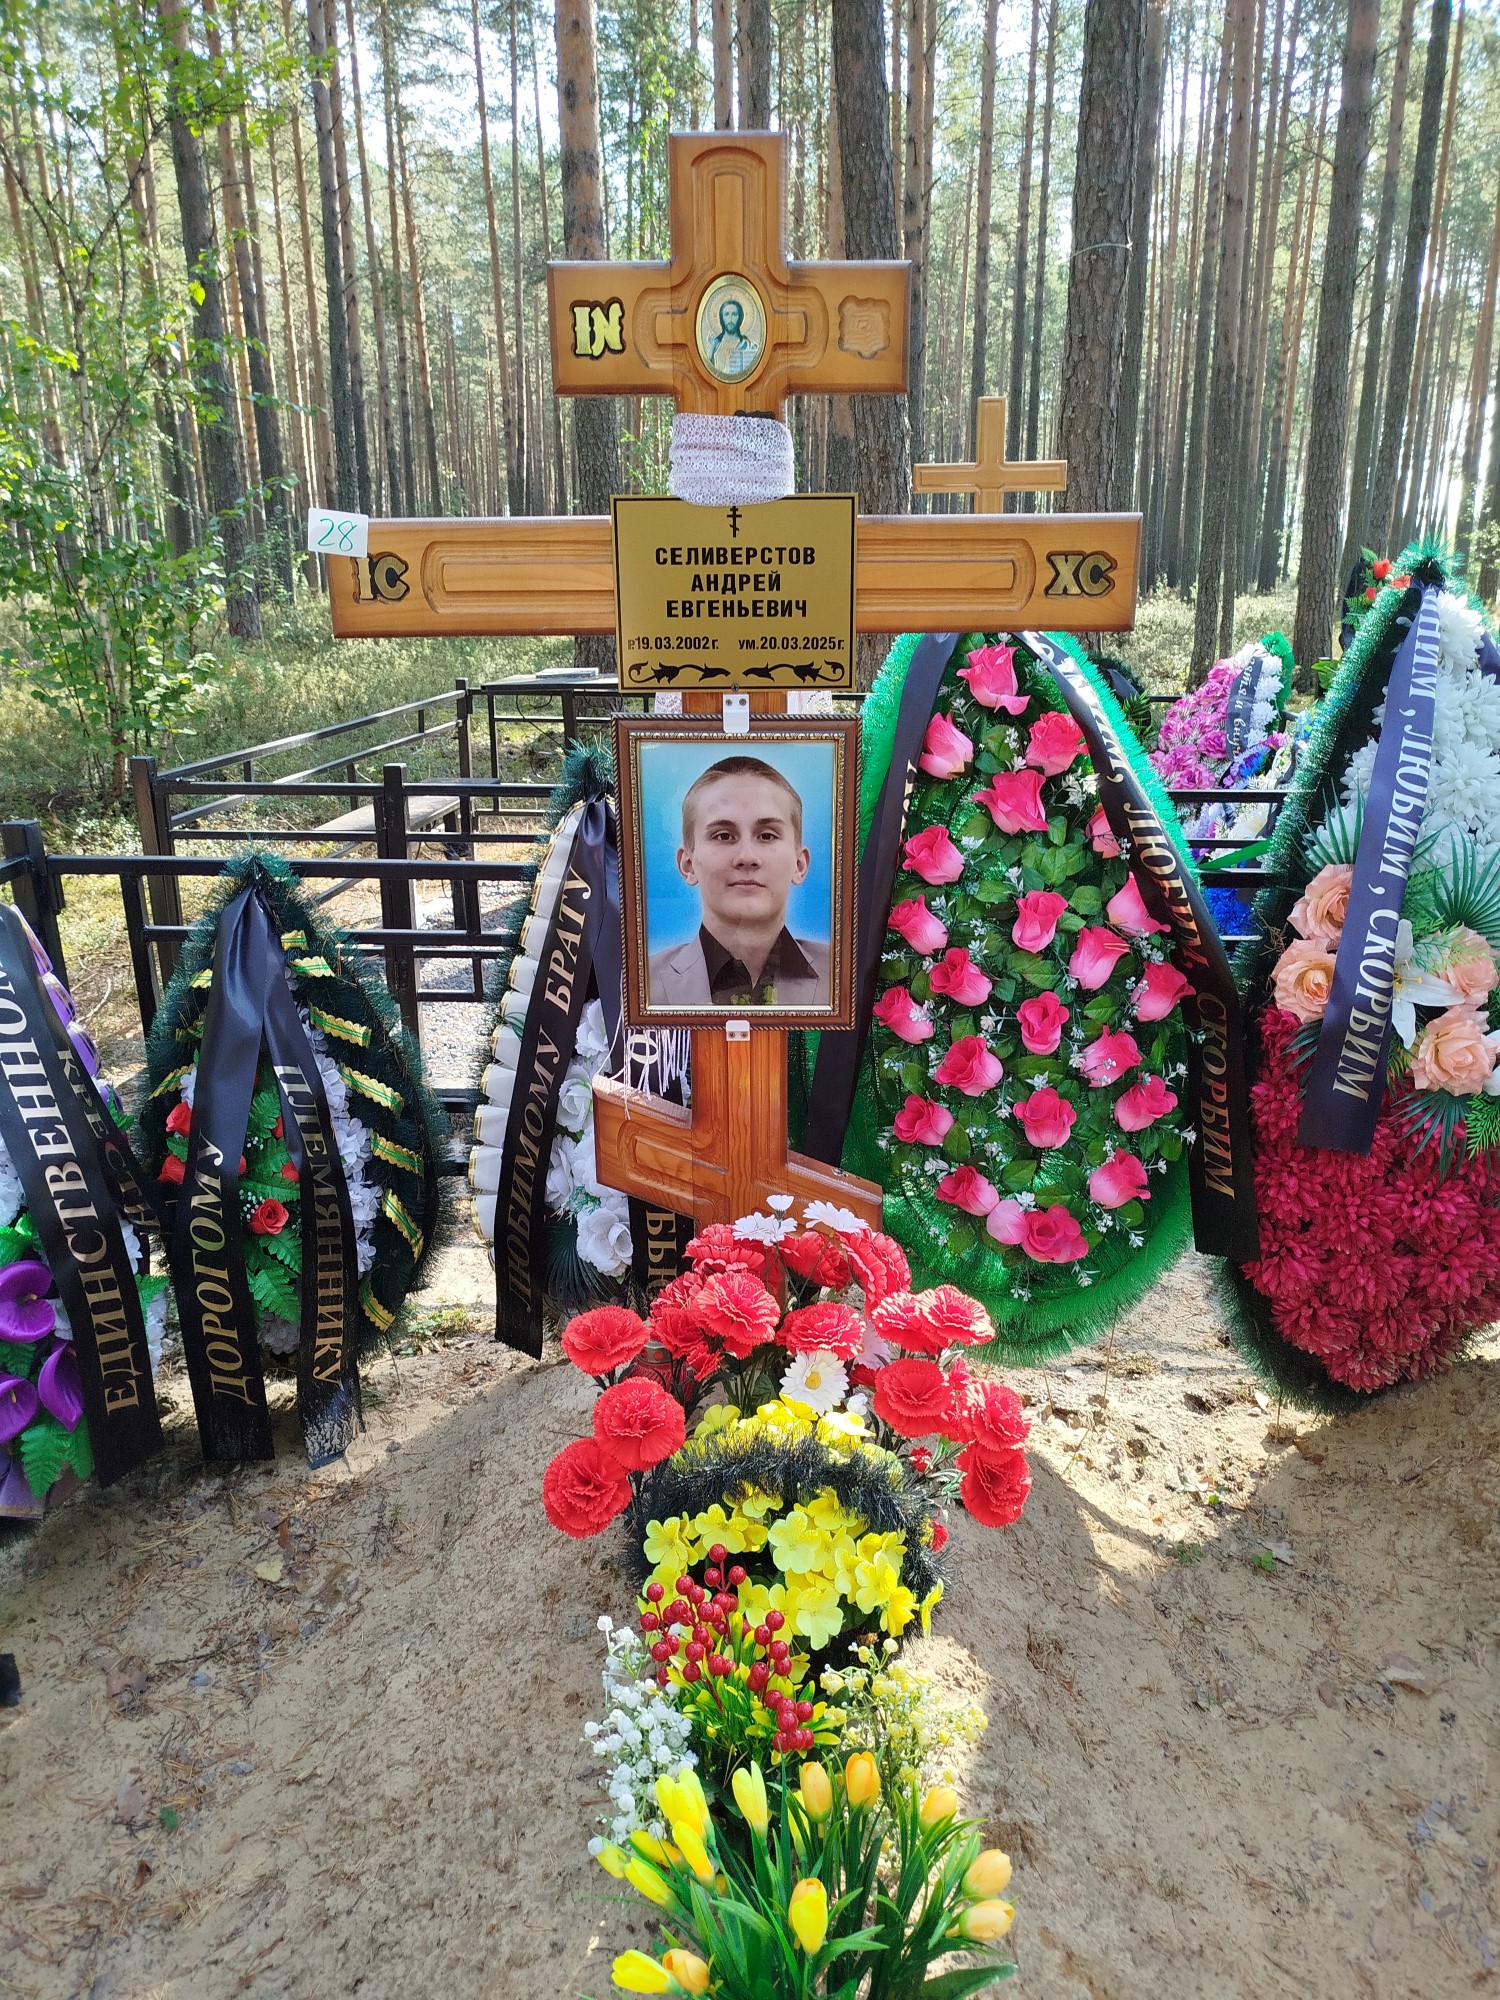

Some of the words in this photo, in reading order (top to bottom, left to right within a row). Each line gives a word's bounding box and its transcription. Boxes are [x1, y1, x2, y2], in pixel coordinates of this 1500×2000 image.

[317, 517, 358, 552] 28
[655, 546, 816, 566] СЕЛИВЕРСТОВ
[690, 570, 782, 595] АНДРЕЙ
[666, 599, 808, 618] ЕВГЕНЬЕВИЧ
[1332, 908, 1399, 1104] СКОРБИМ
[508, 1023, 562, 1314] ЛЮБИМОМУ
[545, 870, 593, 1017] БРАТУ
[1196, 991, 1236, 1201] СКОРБИМ
[189, 1132, 259, 1407] ДОРОГОМУ
[273, 1064, 345, 1387] ПЛЕМЯННИКУ
